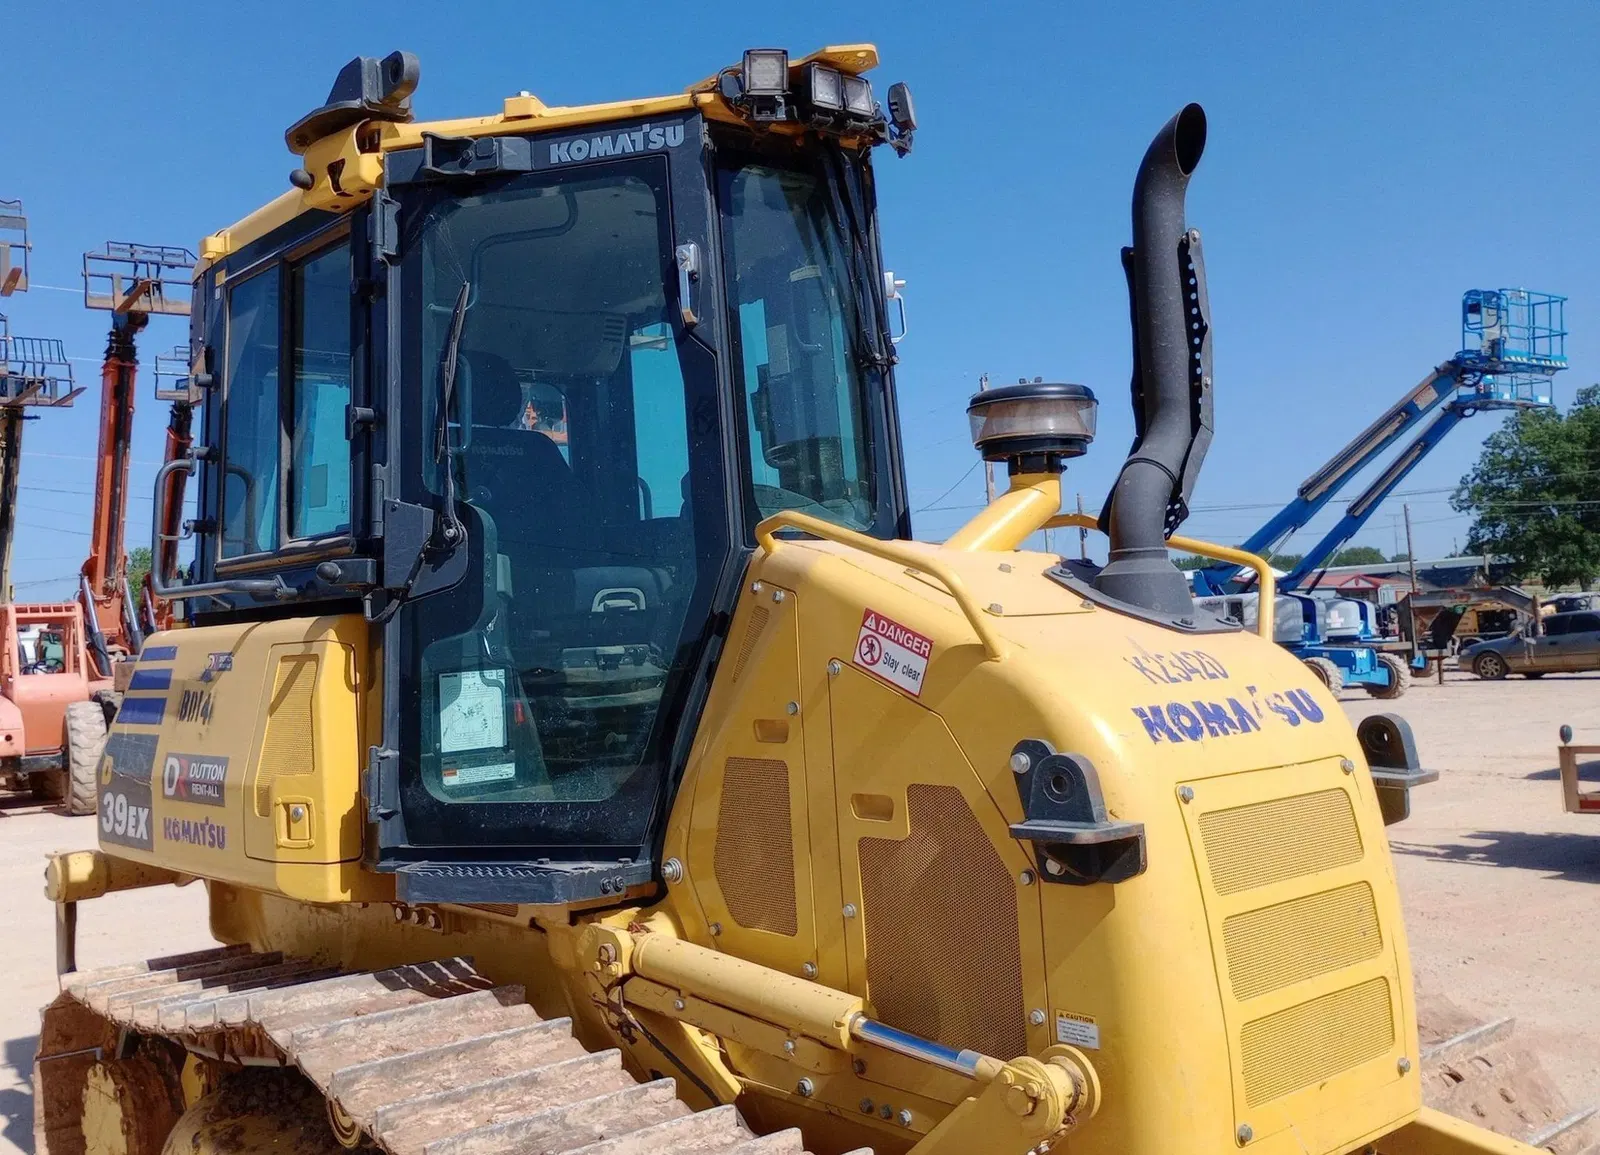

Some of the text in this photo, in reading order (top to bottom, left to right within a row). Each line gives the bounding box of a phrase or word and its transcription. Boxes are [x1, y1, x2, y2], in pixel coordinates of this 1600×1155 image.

[550, 123, 684, 163] KOMATSU
[878, 619, 931, 657] DANGER
[883, 652, 921, 682] Stay clear
[190, 762, 225, 781] DUTTON
[191, 783, 219, 798] RENT-ALL
[102, 792, 150, 840] 39EX
[164, 816, 226, 850] KOMATSU
[1066, 1013, 1094, 1023] CAUTION
